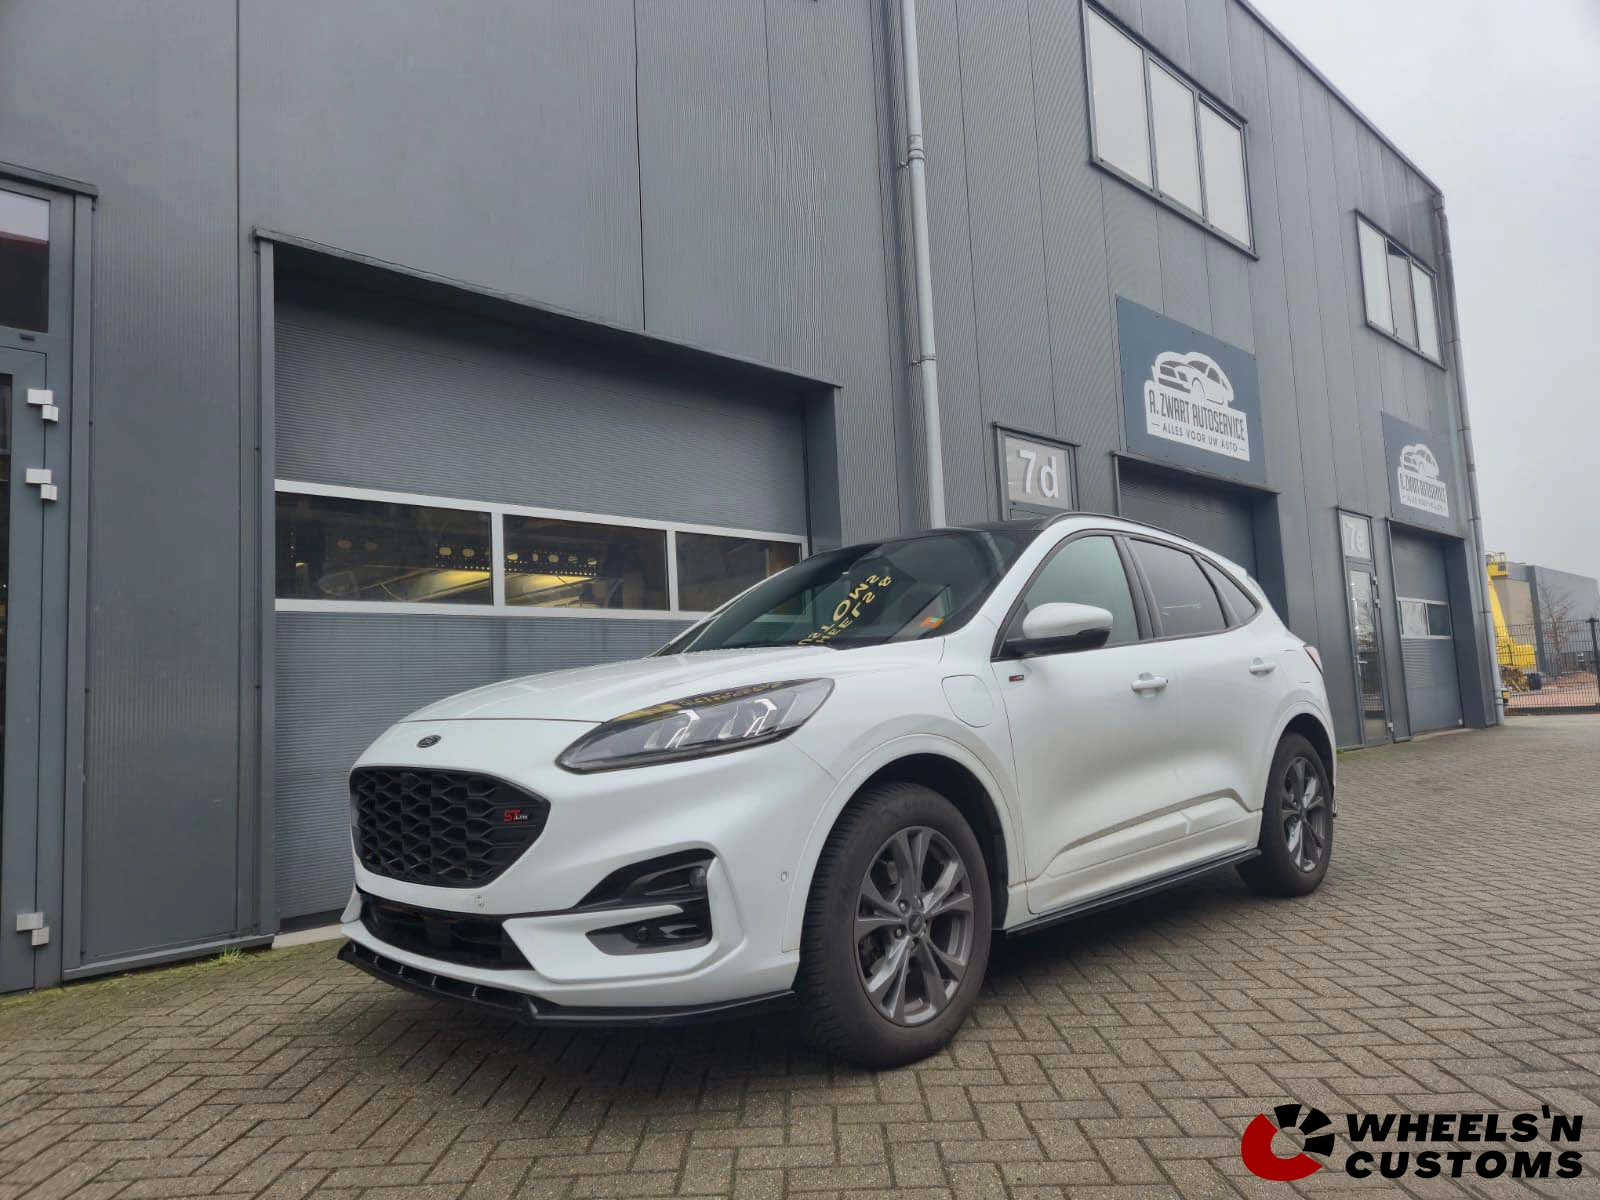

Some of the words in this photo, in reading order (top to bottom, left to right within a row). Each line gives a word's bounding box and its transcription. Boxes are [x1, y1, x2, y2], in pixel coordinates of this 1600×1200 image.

[1160, 393, 1190, 424] ZWART
[1192, 404, 1246, 441] AUTOSERVICE
[1162, 423, 1184, 436] ALLES
[1186, 430, 1206, 443] VOOR
[1221, 440, 1238, 452] AUTO
[1017, 449, 1059, 498] 7d
